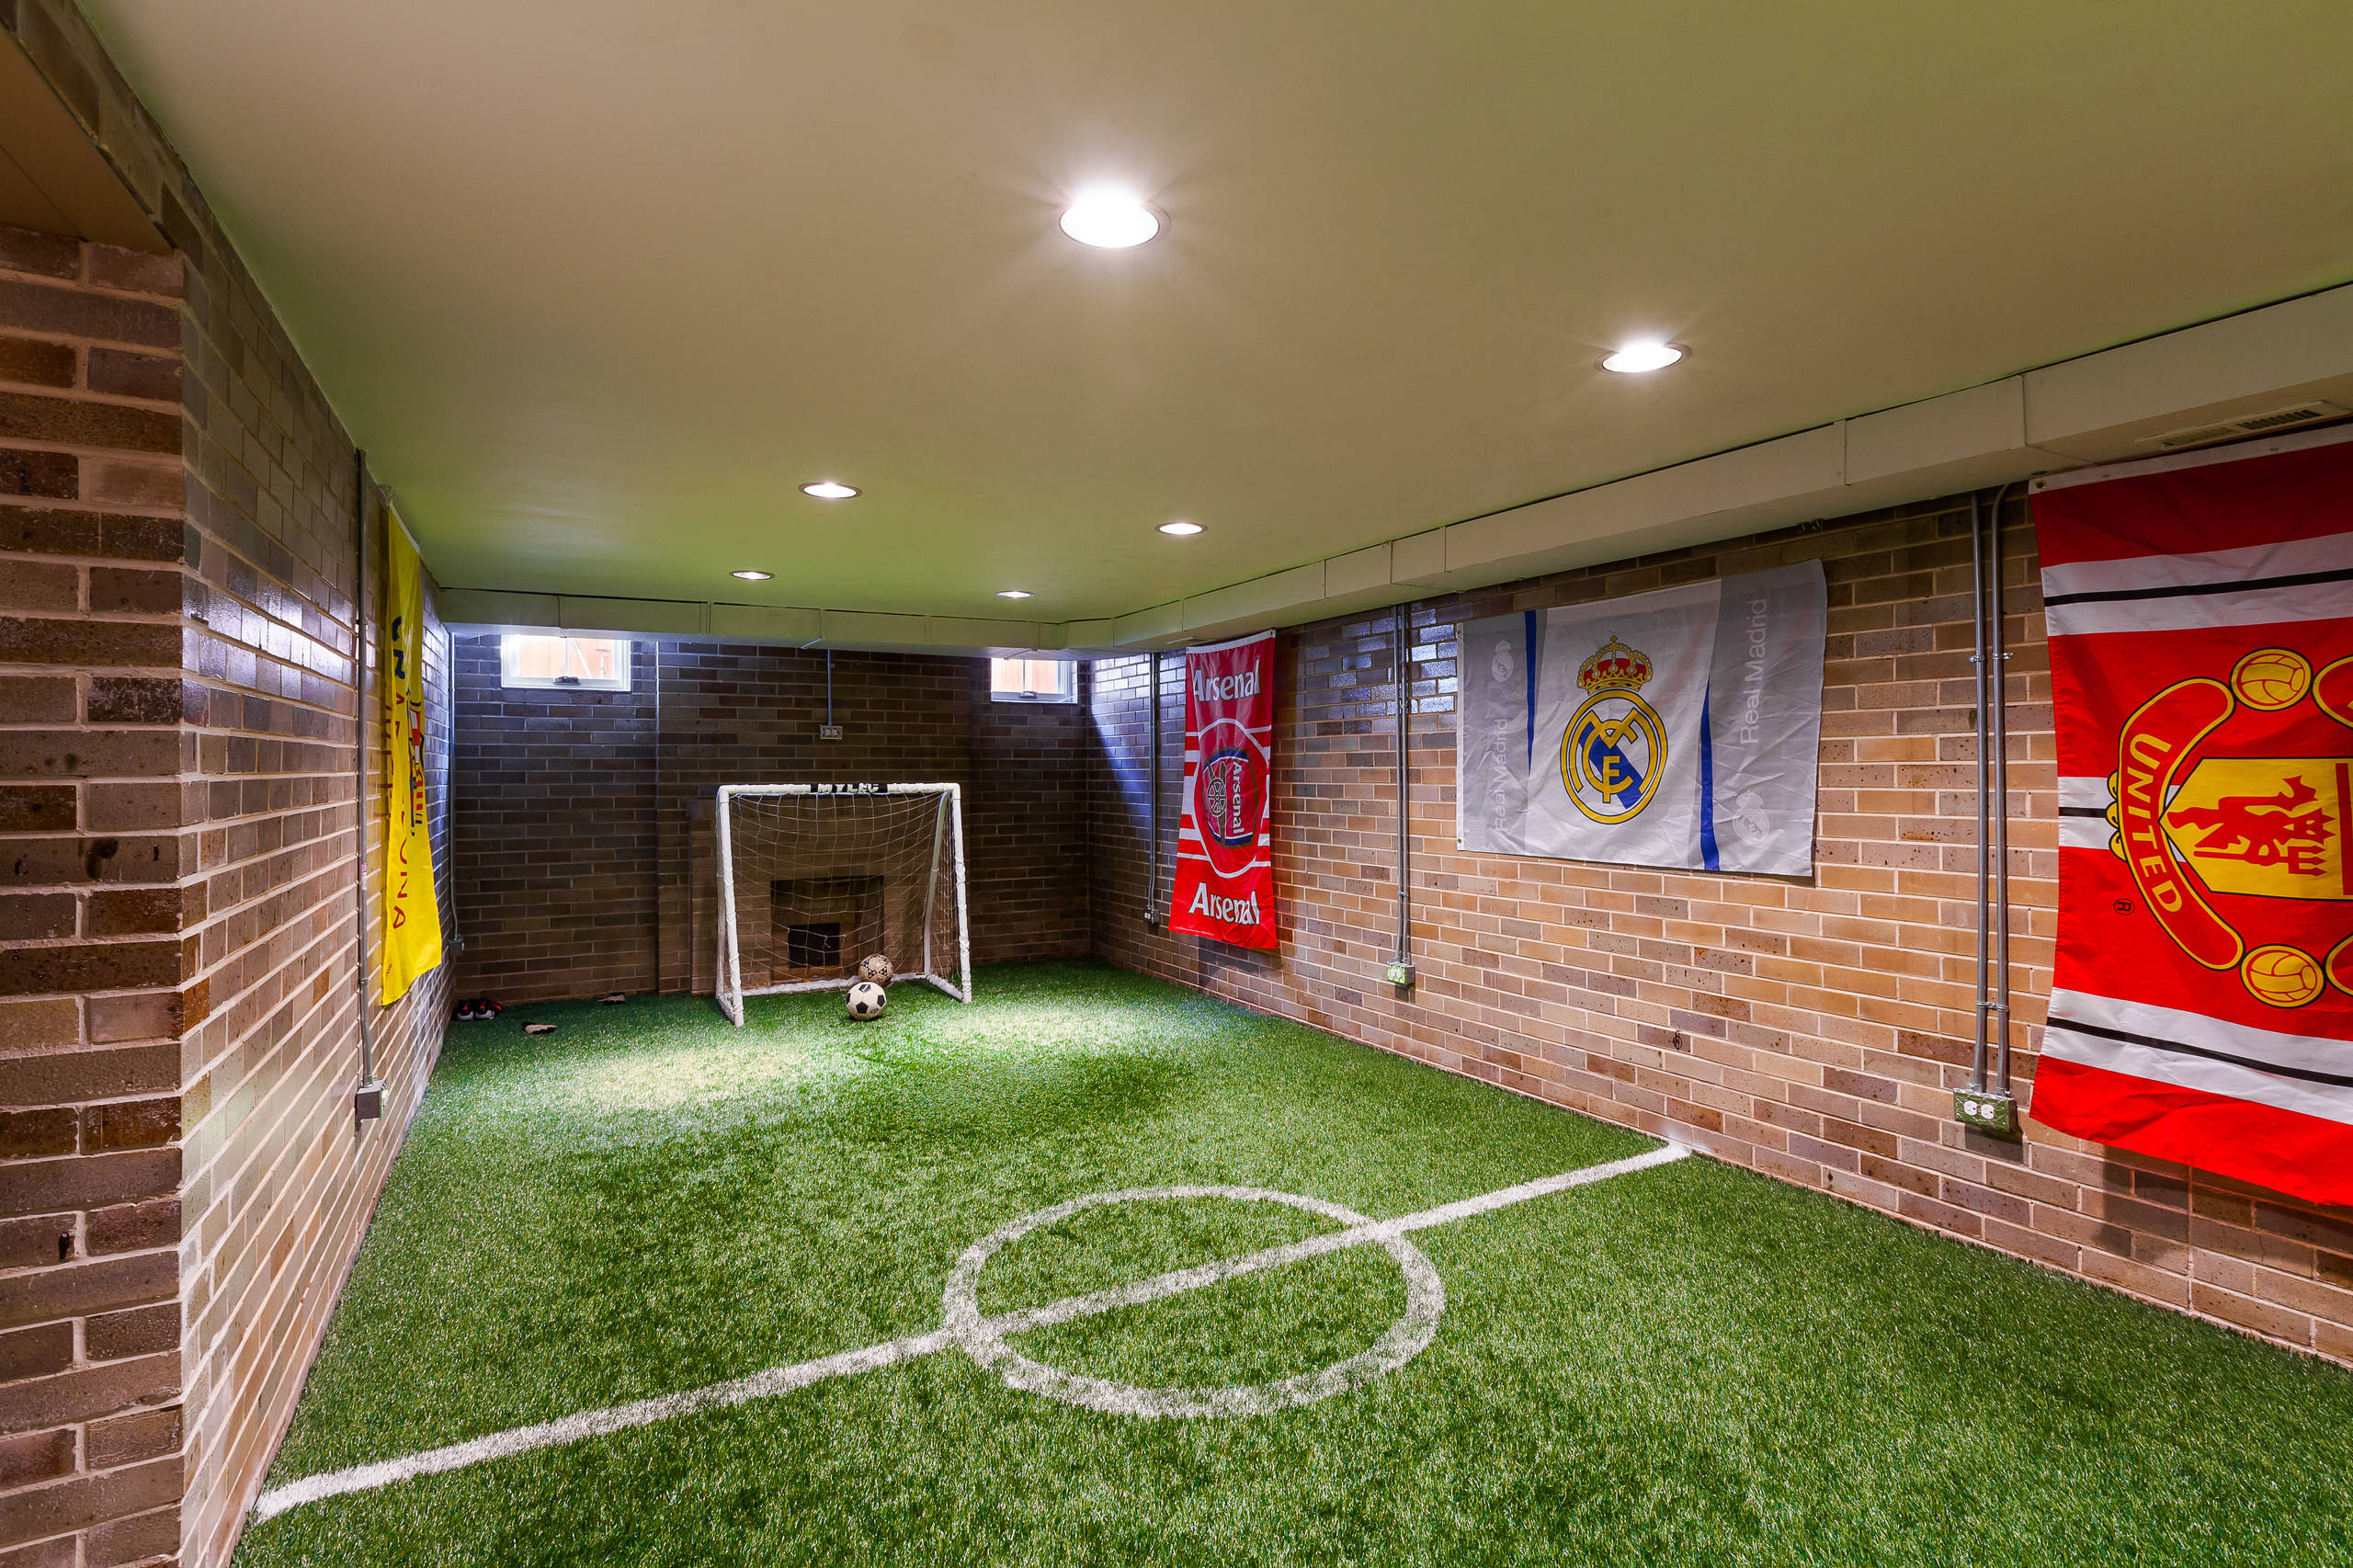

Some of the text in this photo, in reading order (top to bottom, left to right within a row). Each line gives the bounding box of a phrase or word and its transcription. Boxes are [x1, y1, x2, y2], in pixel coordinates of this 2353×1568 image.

[1193, 657, 1261, 702] Arsenal
[1740, 597, 1768, 744] Real Madrid
[1493, 719, 1508, 781] Madrid
[1233, 761, 1245, 835] Arsenal
[2127, 733, 2183, 913] UNITED
[1188, 881, 1260, 926] Arsenal
